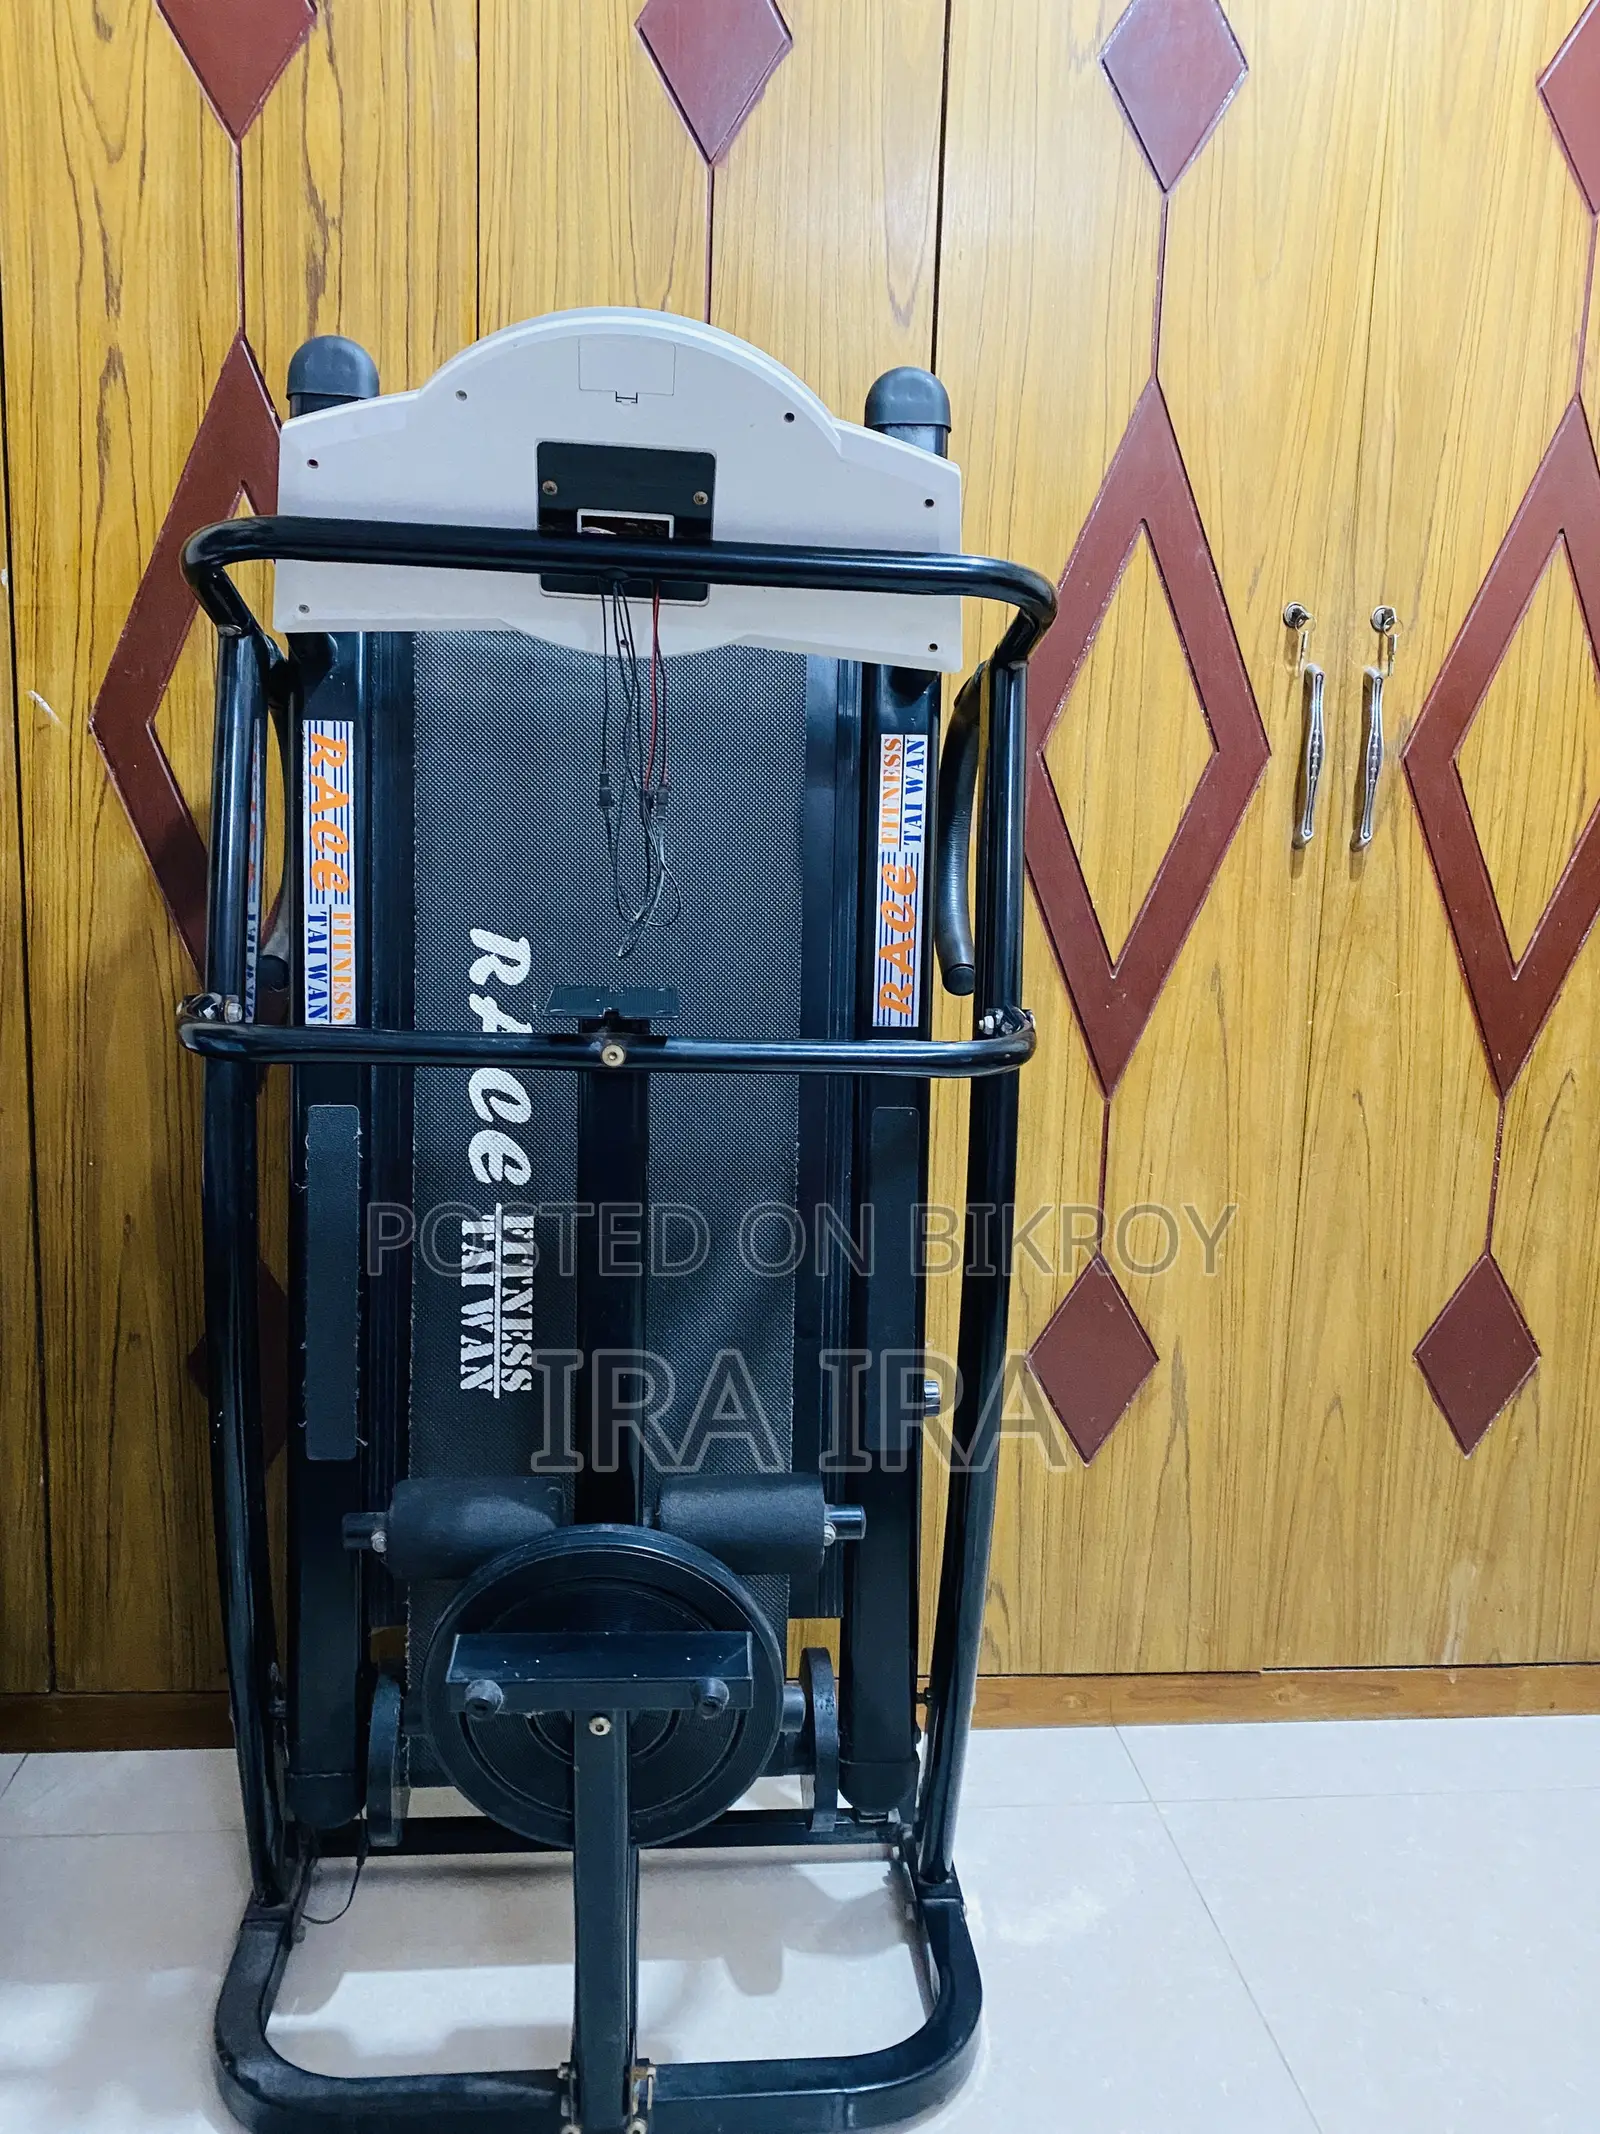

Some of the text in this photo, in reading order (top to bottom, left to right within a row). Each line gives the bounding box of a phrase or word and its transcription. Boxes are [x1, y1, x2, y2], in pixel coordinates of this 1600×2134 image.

[881, 738, 902, 845] FITNESS
[332, 911, 352, 1021] FITNESS
[501, 1215, 535, 1392] FITNESS
